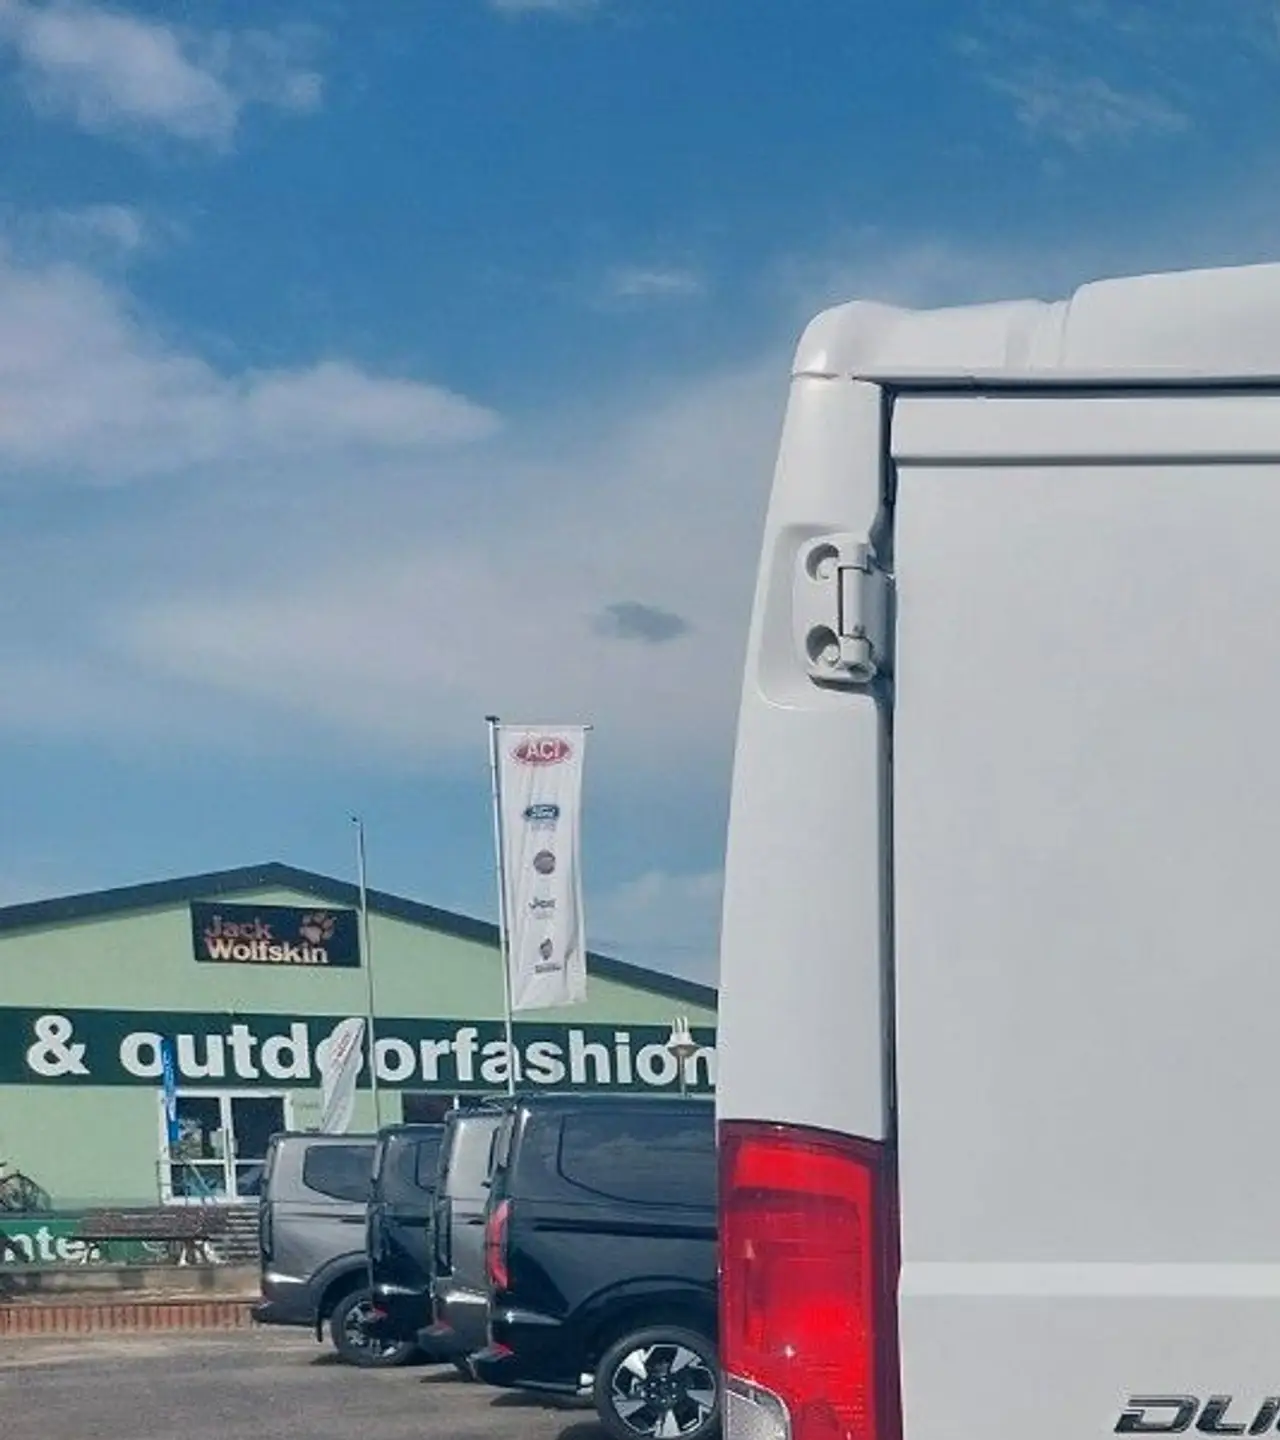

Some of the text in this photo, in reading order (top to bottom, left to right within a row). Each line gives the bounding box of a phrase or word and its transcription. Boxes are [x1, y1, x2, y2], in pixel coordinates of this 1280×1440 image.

[525, 740, 561, 760] ACI
[204, 911, 272, 938] Jack
[204, 936, 329, 964] Wolfskin
[27, 1015, 91, 1076] &
